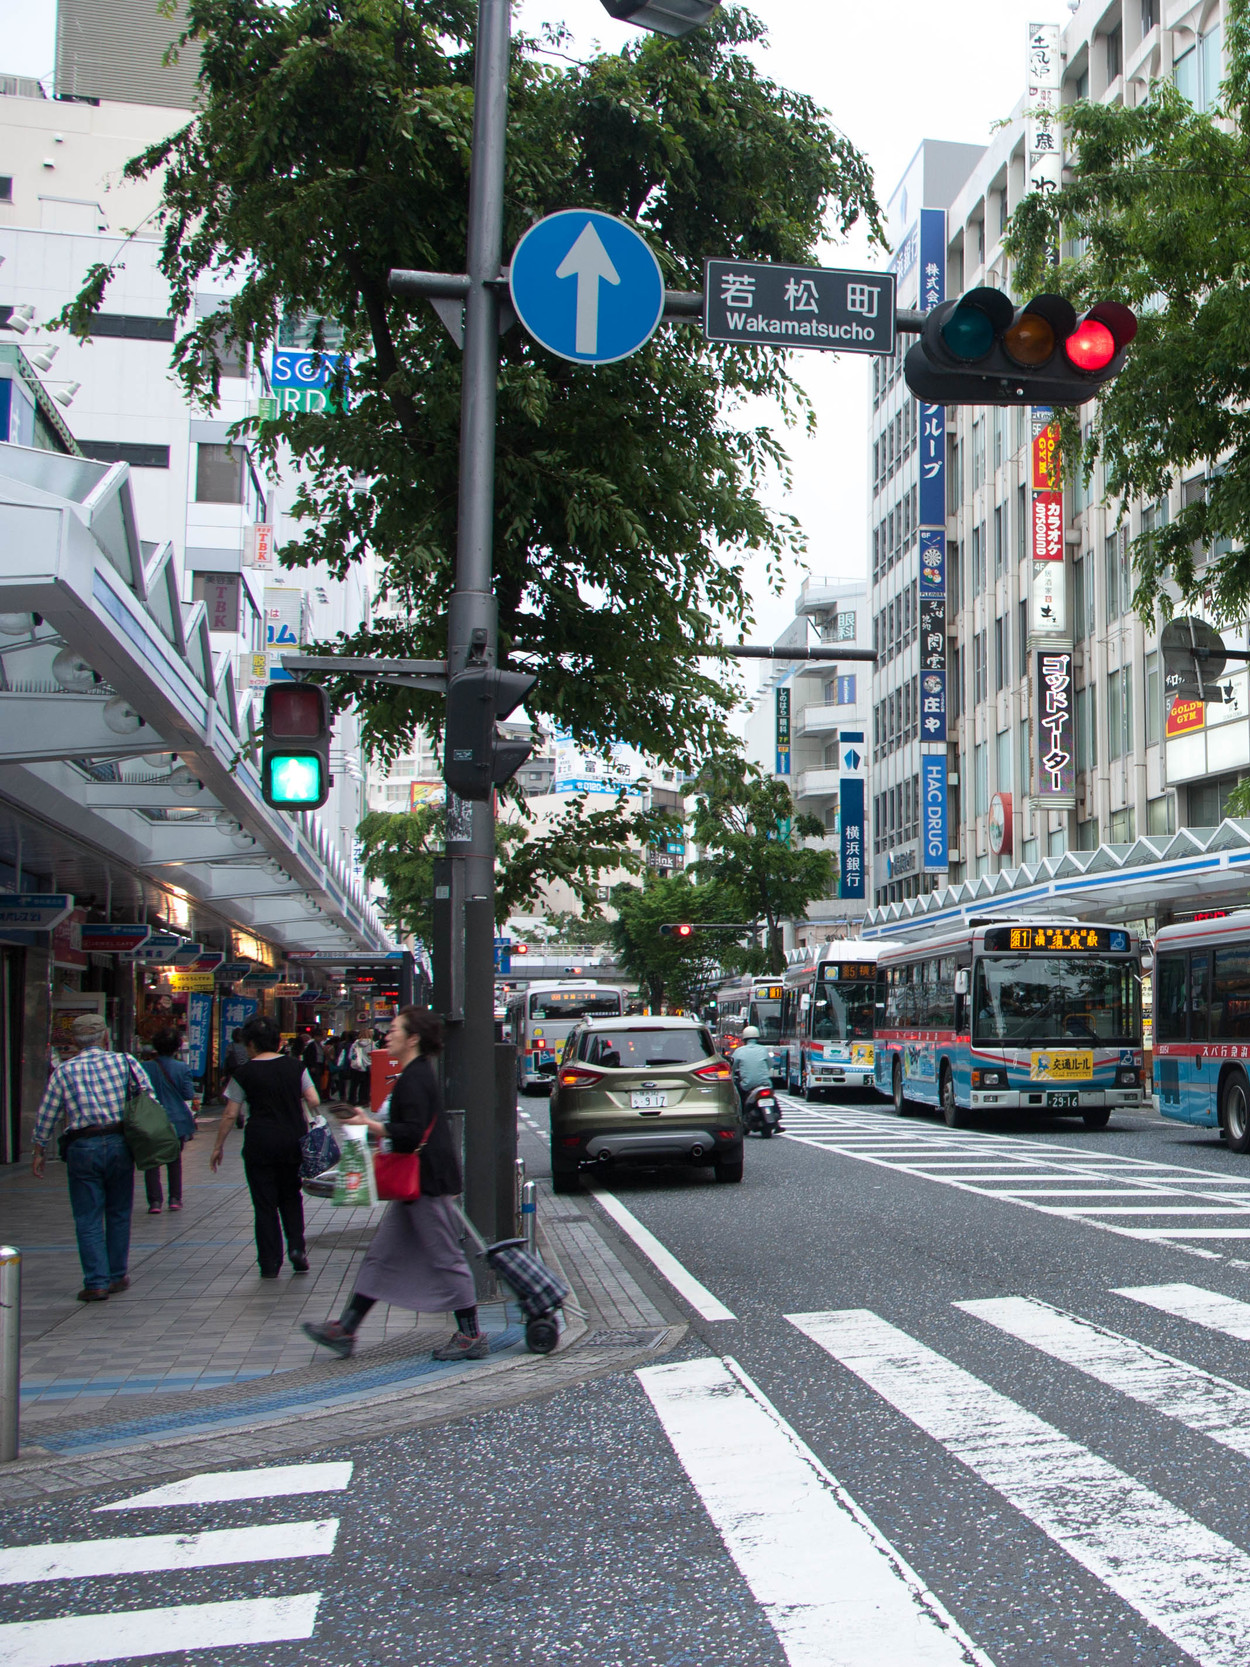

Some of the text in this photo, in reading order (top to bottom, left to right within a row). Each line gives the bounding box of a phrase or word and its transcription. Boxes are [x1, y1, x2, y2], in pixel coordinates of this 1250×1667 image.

[720, 273, 881, 318] 若松町
[726, 311, 875, 342] Wakamatsucho
[1038, 437, 1047, 477] GYM
[1035, 501, 1047, 556] JOYSOUND
[1046, 502, 1062, 556] カラオケ
[257, 533, 269, 561] TBK
[1034, 562, 1045, 571] 4F
[213, 586, 227, 628] TBK
[837, 612, 855, 639] 眼科
[252, 655, 267, 678] 脱毛
[1166, 699, 1171, 711] 5
[1171, 700, 1203, 716] GOLD'S
[1176, 711, 1197, 724] GYM
[1042, 654, 1070, 792] ゴッドイーター
[926, 765, 943, 857] HAC DRUG
[845, 825, 861, 888] 横浜銀行
[1052, 1052, 1092, 1071] 交通ルール
[1051, 1096, 1078, 1108] 29-16
